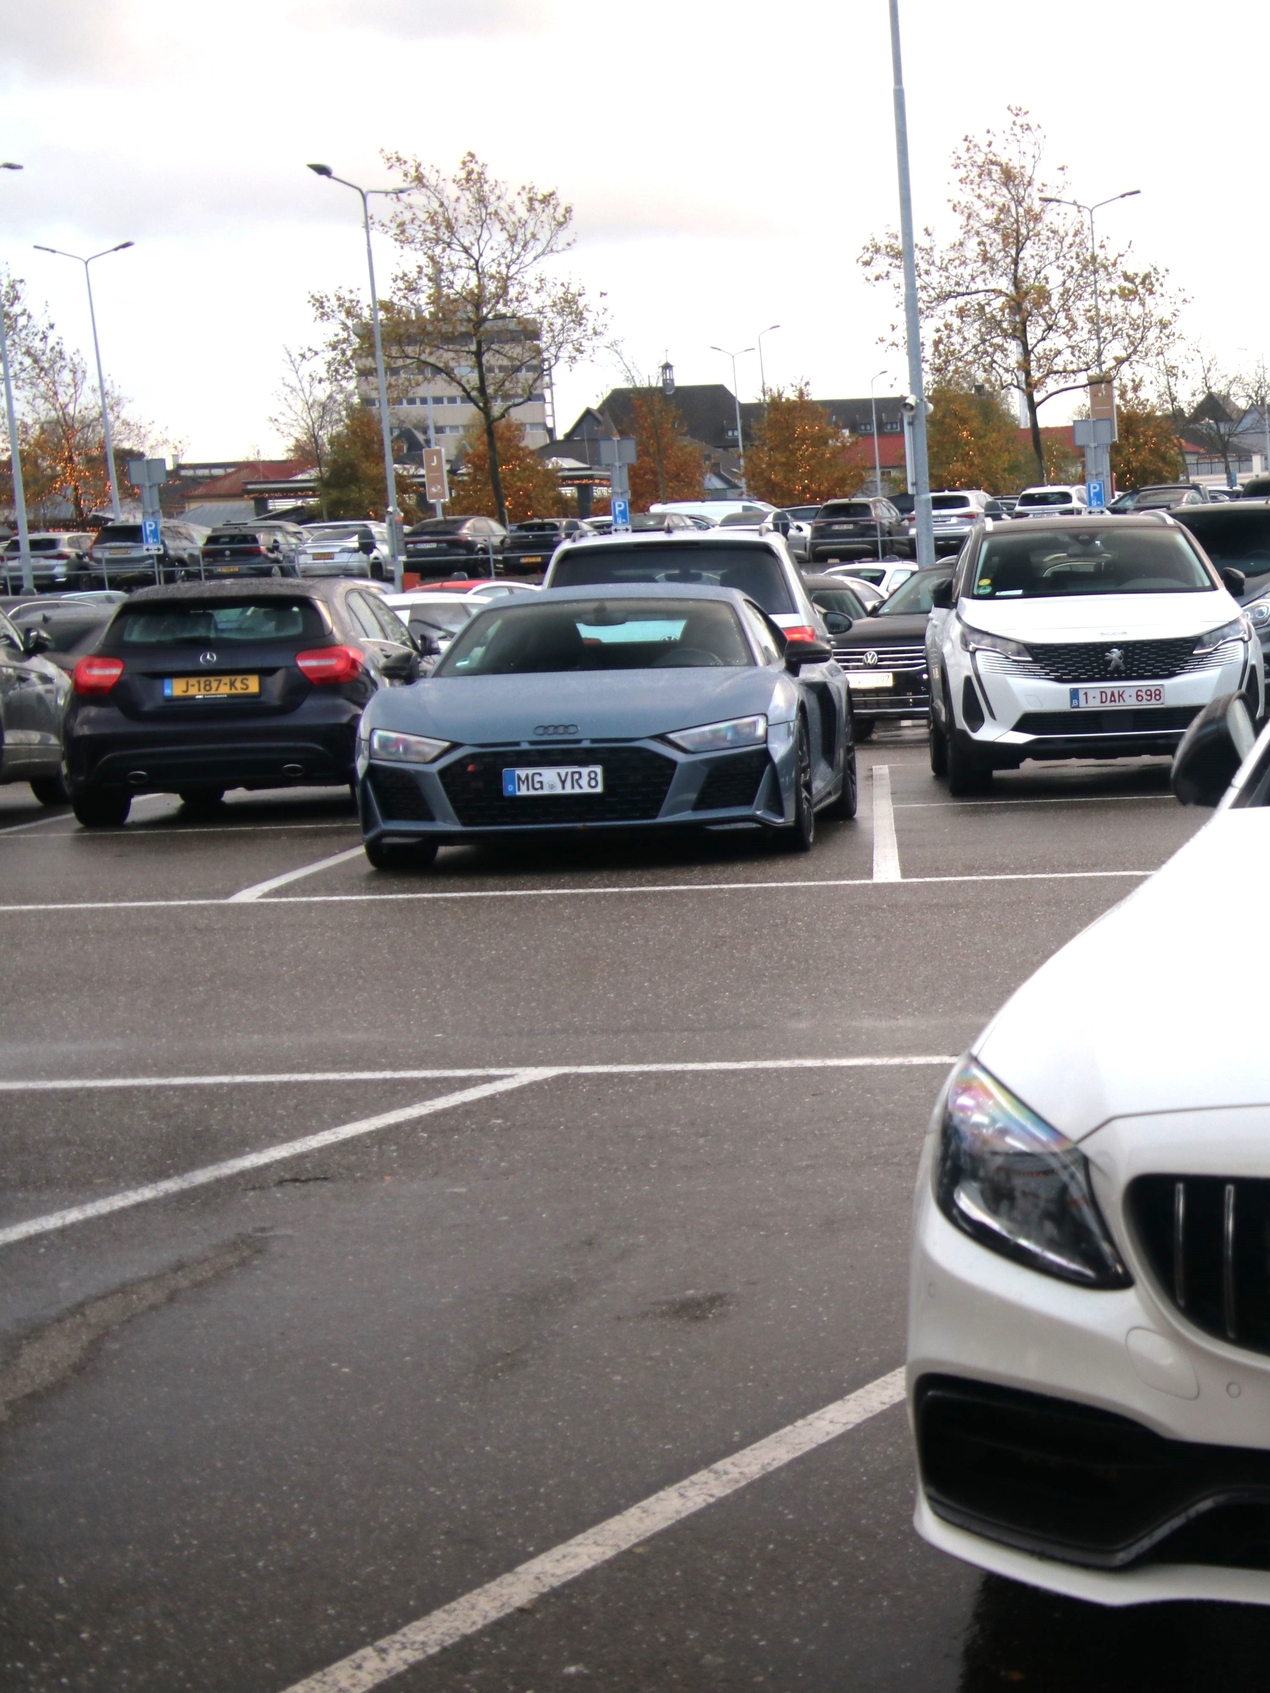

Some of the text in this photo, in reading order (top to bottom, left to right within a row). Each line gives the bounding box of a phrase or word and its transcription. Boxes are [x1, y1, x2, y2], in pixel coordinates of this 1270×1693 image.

[431, 455, 437, 466] J
[1089, 483, 1100, 498] P
[615, 501, 625, 515] P
[146, 521, 155, 535] P
[182, 677, 249, 693] J-187-KS
[516, 770, 599, 792] MG YR 8
